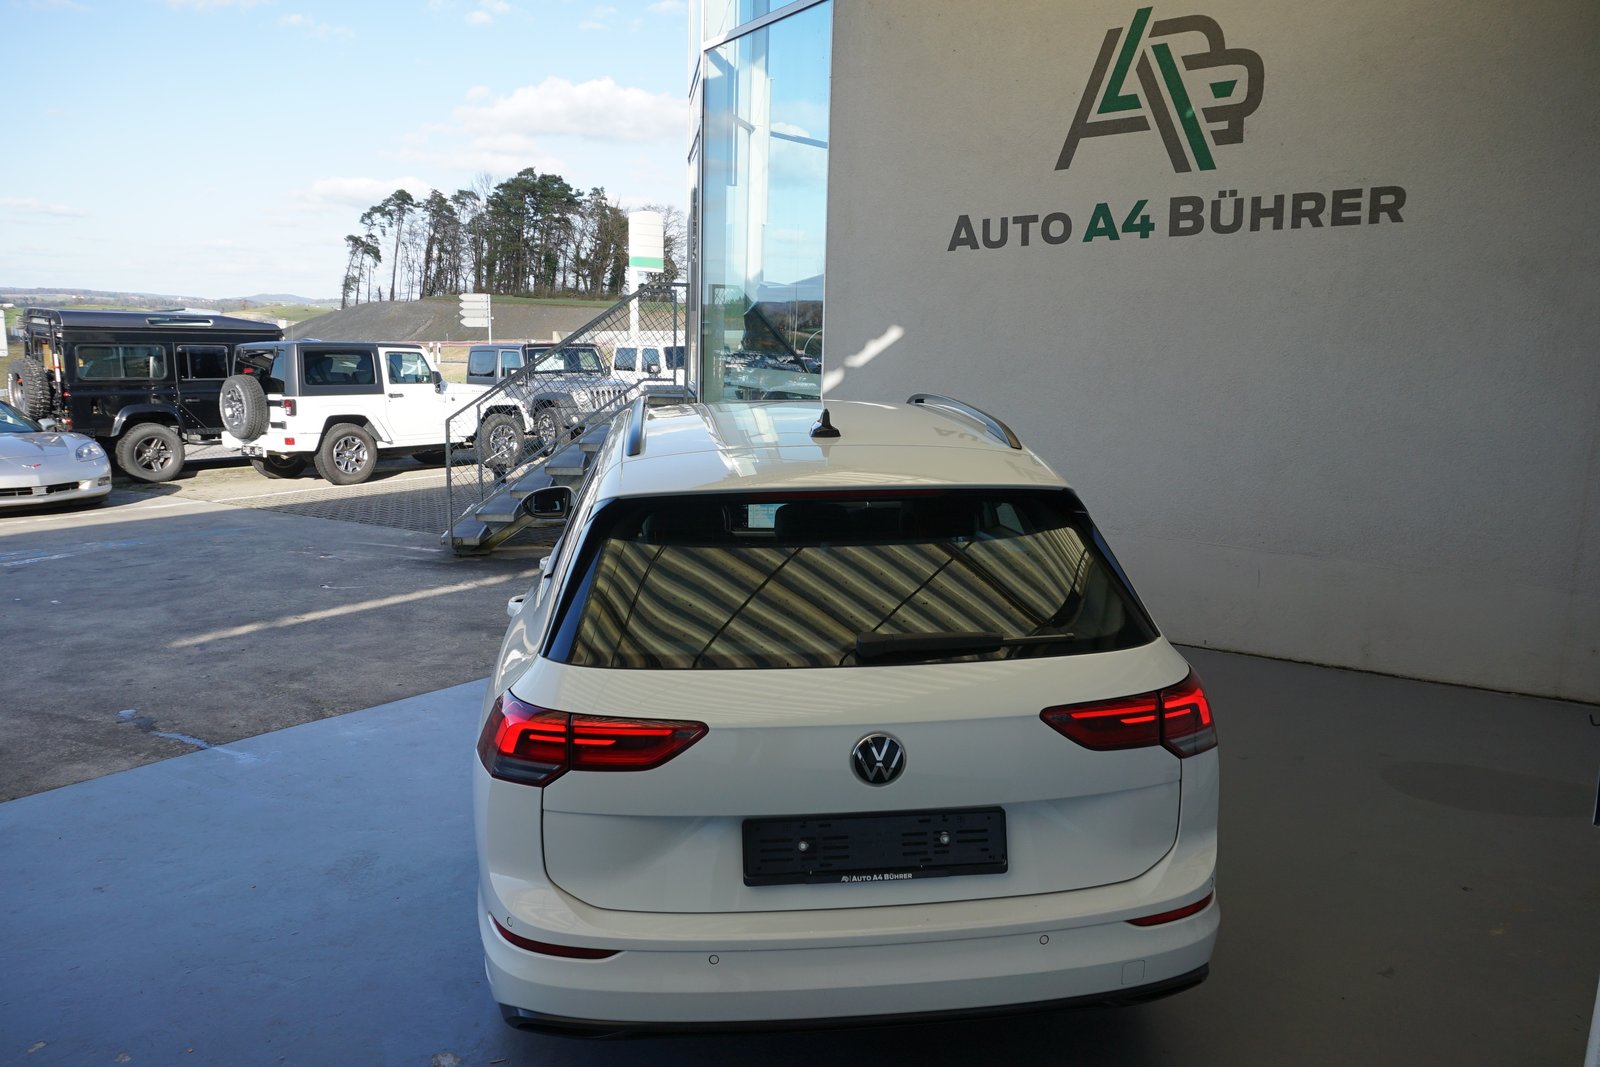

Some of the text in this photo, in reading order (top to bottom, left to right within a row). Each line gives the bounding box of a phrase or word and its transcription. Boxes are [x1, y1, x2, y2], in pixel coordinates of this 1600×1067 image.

[947, 185, 1407, 252] AUTO A4 BÜHRER
[884, 873, 913, 881] BÜHRER
